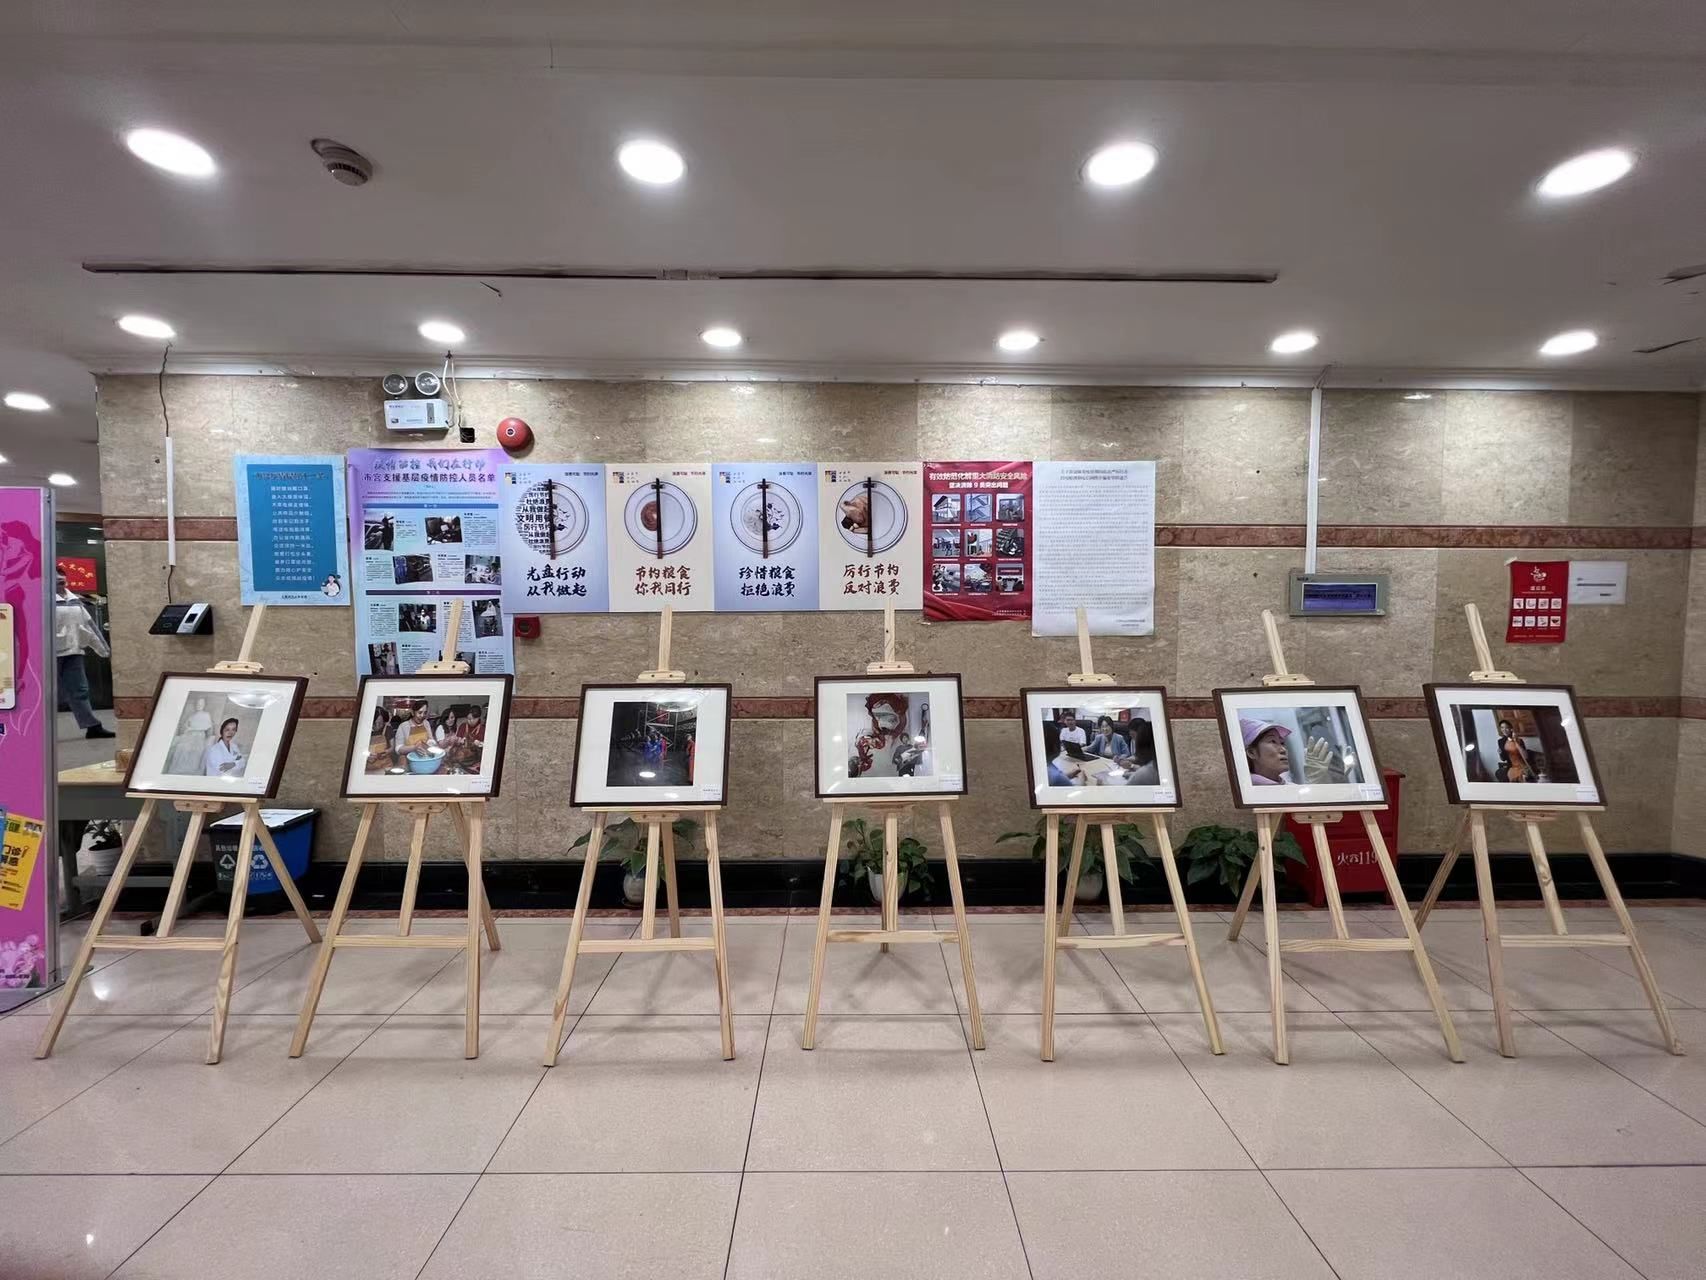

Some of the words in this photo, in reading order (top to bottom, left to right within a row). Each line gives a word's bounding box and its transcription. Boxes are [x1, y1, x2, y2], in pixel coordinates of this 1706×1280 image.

[527, 564, 586, 581] 光盘行动
[635, 565, 691, 581] 节约粮食
[739, 565, 795, 580] 珍惜粮食
[843, 563, 899, 579] 厉行节约
[527, 581, 587, 597] 从我做起
[635, 581, 692, 596] 你我同行
[740, 581, 796, 597] 拒绝浪费
[843, 578, 900, 595] 反对浪费
[1359, 851, 1377, 865] 119
